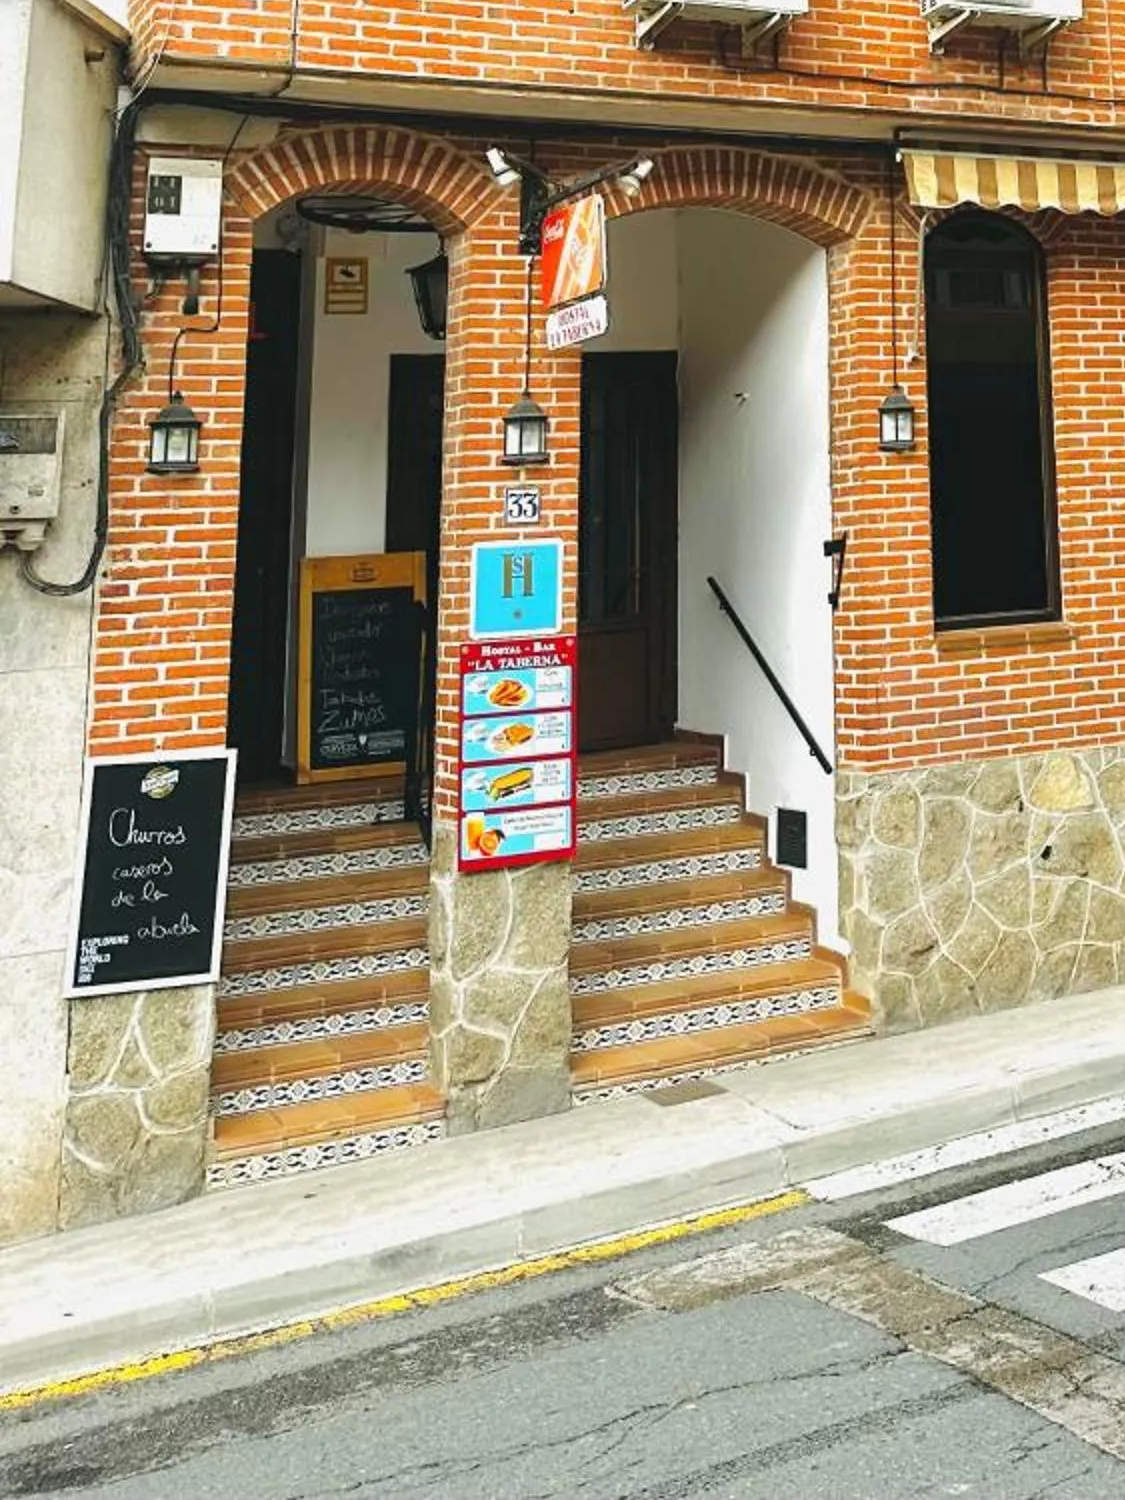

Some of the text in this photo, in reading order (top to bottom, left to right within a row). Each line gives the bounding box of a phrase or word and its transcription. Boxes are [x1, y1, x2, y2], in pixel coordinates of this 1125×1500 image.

[508, 493, 538, 519] 33
[109, 807, 186, 847] Churros
[112, 856, 173, 880] caseros
[112, 880, 169, 907] de la
[137, 912, 200, 939] abuela
